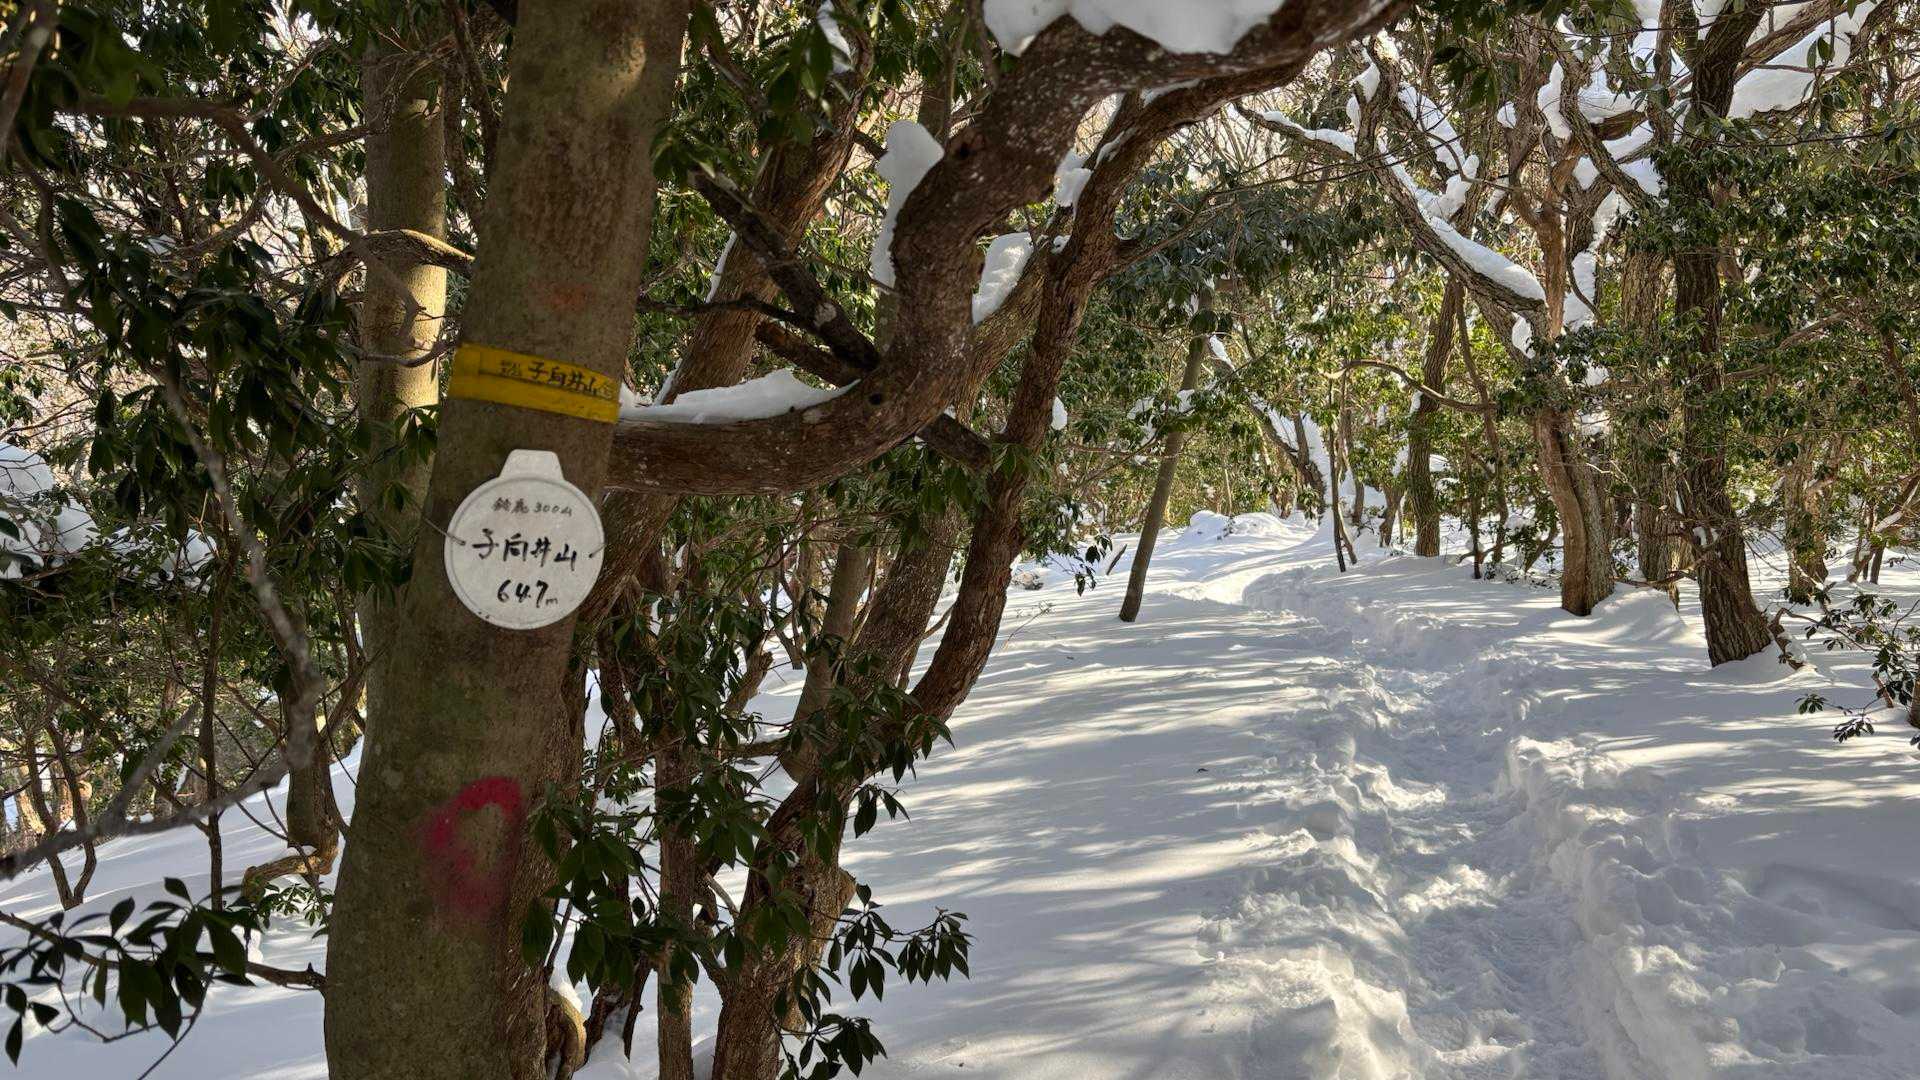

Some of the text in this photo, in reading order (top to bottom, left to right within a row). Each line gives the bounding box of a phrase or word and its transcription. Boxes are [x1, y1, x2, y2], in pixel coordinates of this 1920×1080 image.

[472, 528, 578, 571] 子向井山
[496, 579, 559, 609] 647m
